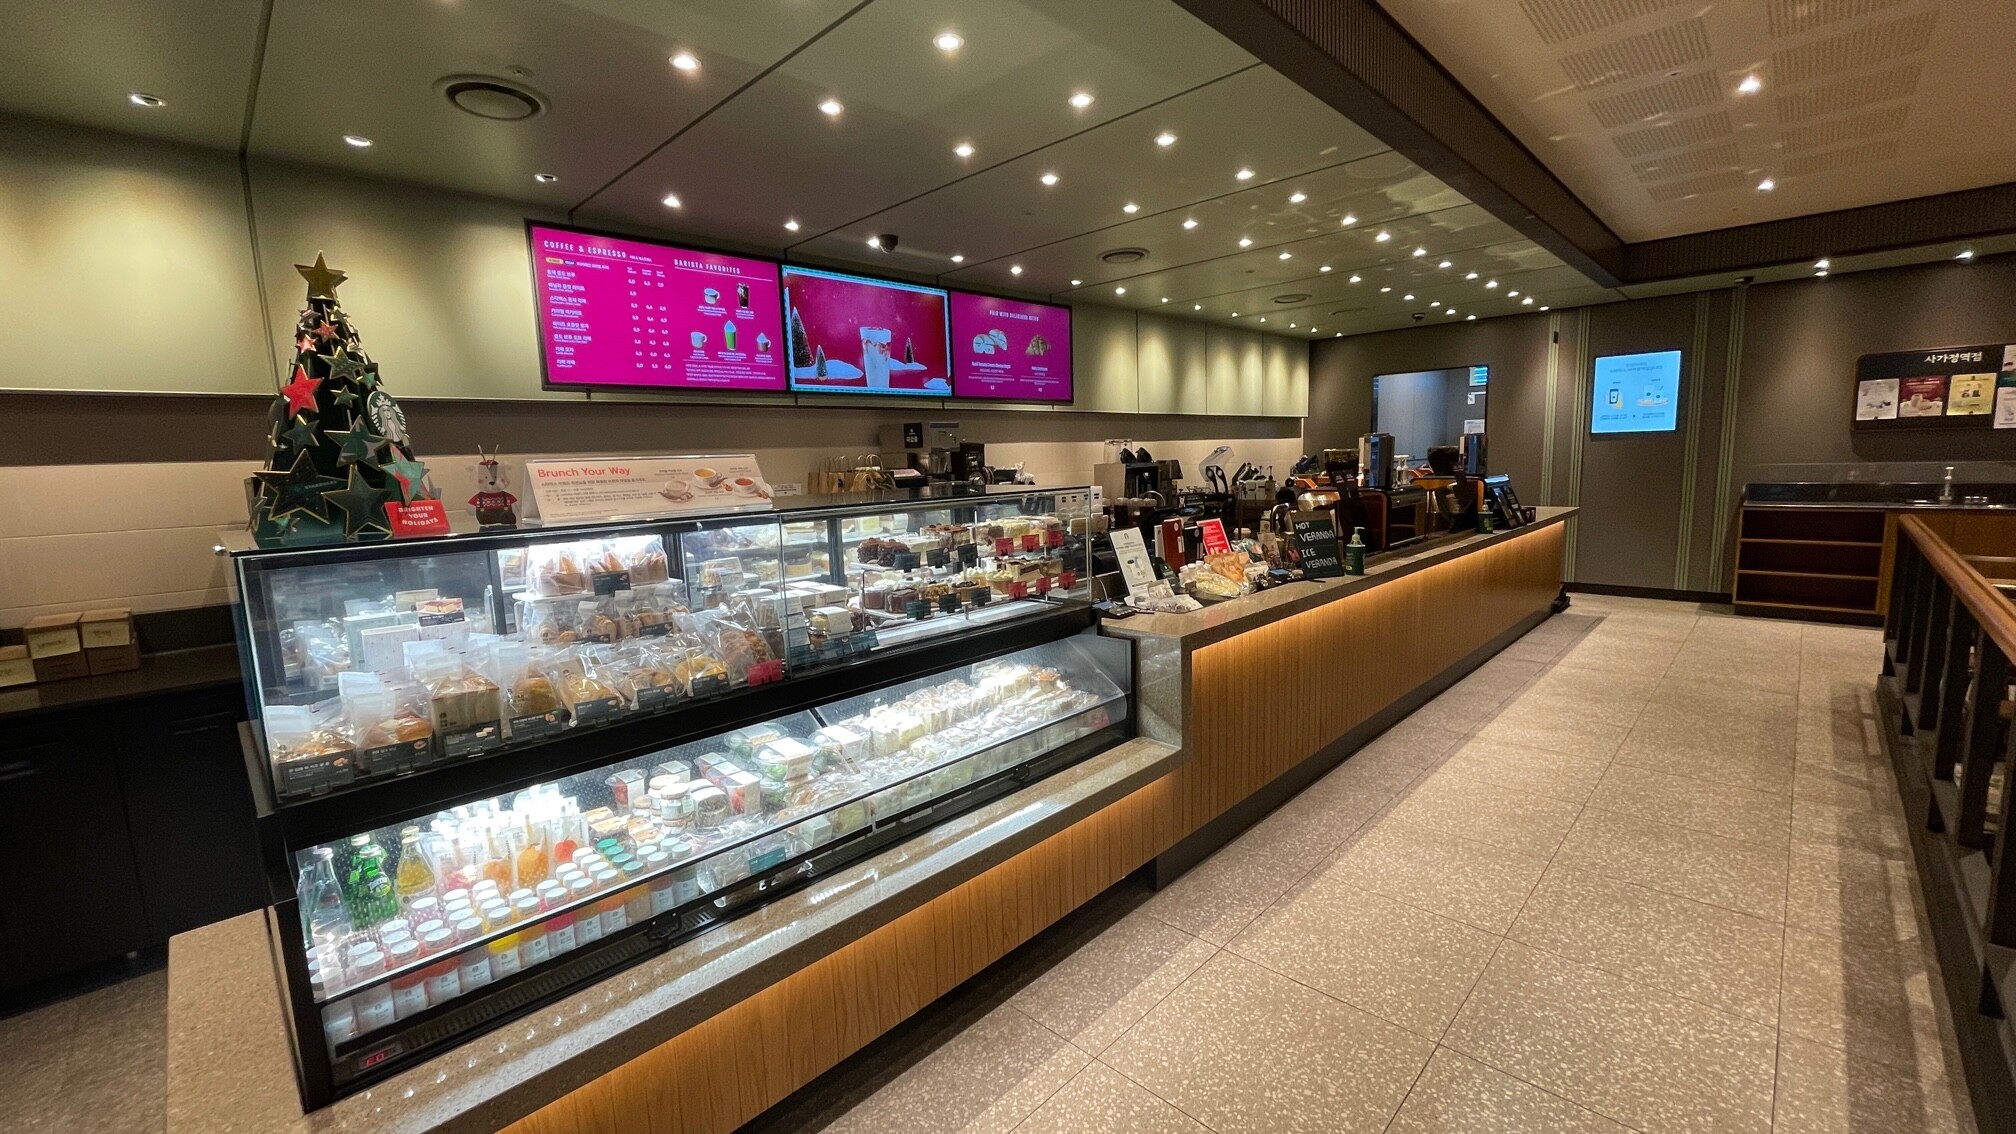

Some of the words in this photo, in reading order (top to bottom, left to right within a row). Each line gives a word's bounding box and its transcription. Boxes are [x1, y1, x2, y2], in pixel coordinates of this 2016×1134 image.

[544, 240, 574, 251] COFFEE
[579, 245, 585, 253] &
[587, 246, 627, 258] ESPRESSO
[674, 258, 703, 269] BARISTA
[706, 263, 741, 275] FAVORITES
[1924, 351, 1983, 364] 사가정역점
[537, 468, 579, 478] Brunch
[581, 467, 606, 477] Your
[608, 466, 631, 477] Way
[398, 505, 434, 513] BRIGHTEN
[402, 517, 439, 526] HOLIDAYS
[1295, 521, 1310, 530] HOT
[1299, 530, 1335, 542] VERANDA
[1300, 548, 1317, 558] ICE
[1305, 556, 1338, 569] VERANDA
